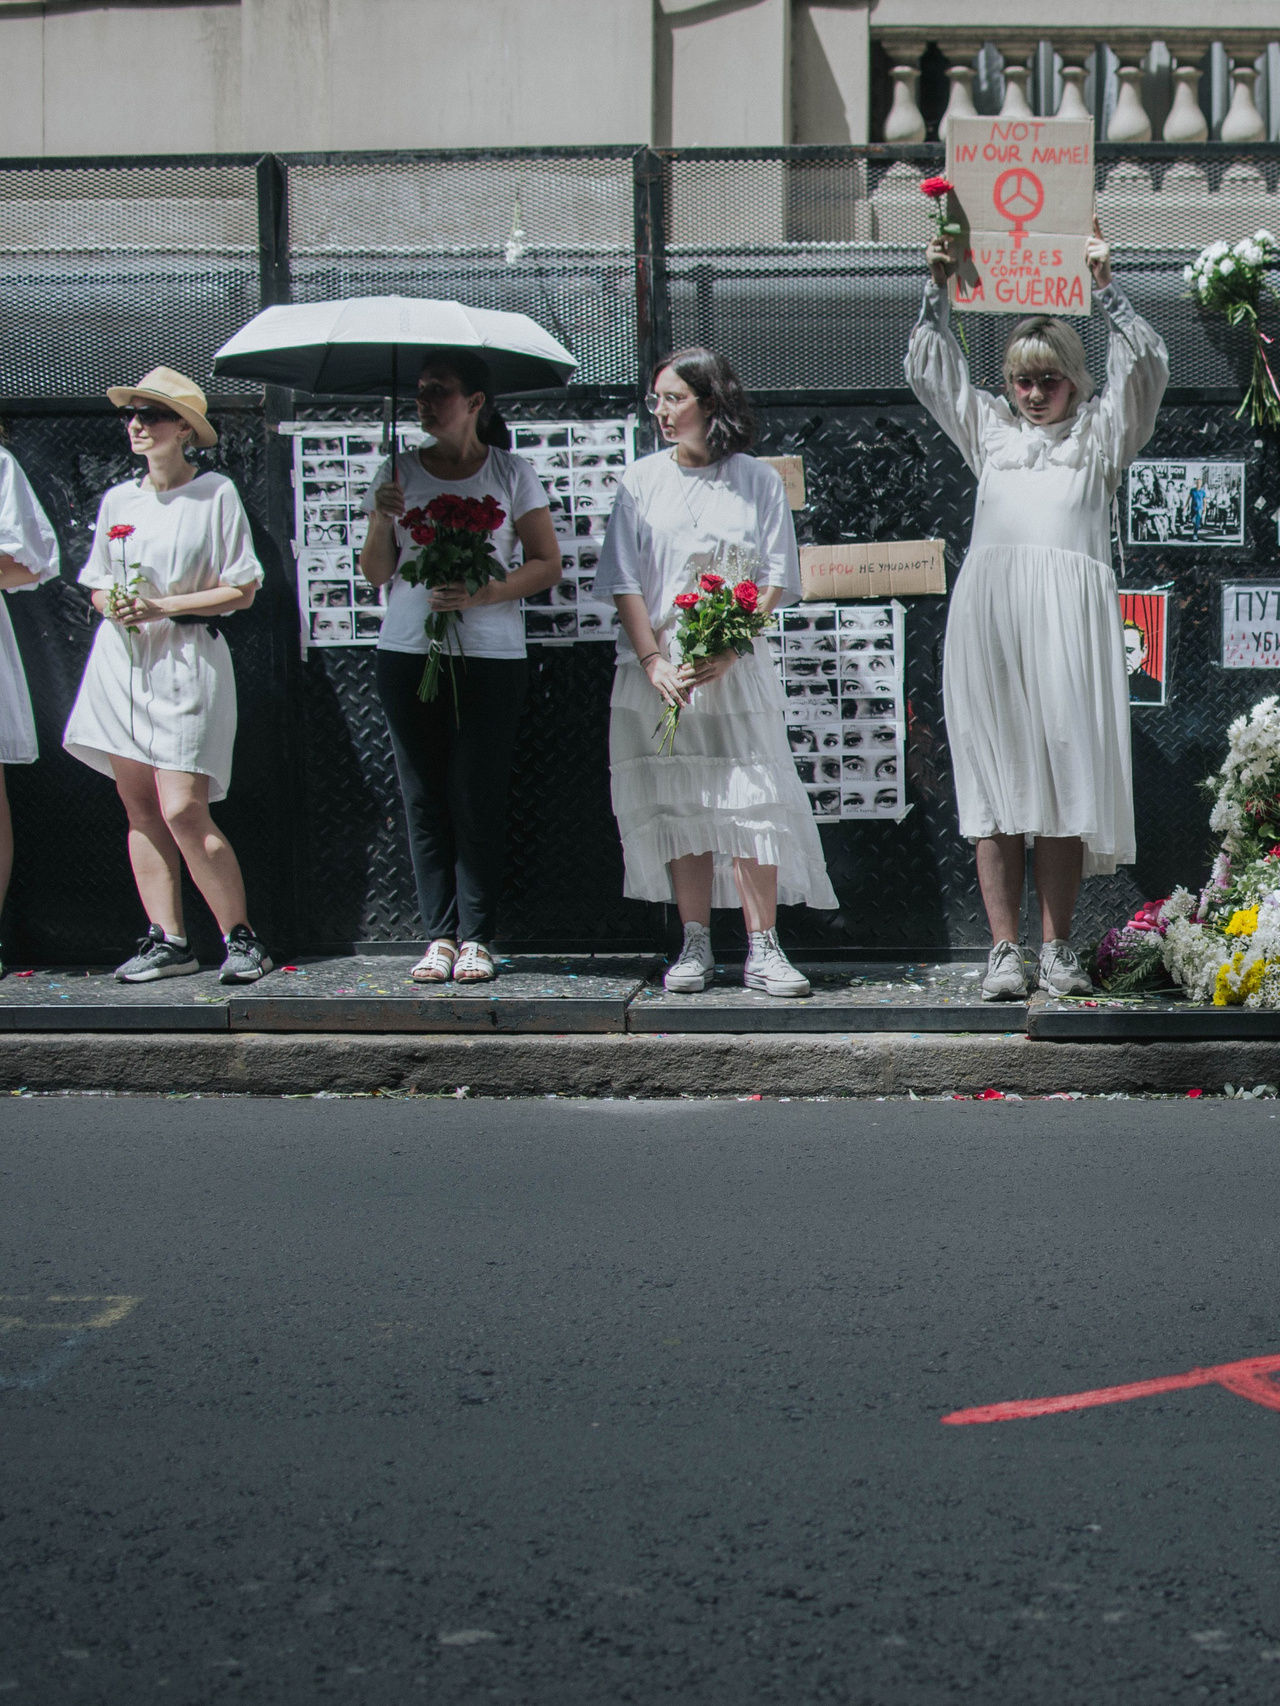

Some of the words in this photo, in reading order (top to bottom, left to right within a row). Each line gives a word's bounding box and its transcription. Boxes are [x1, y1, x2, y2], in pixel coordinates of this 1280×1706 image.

[990, 122, 1046, 142] NOT
[955, 145, 977, 162] IN
[983, 144, 1022, 162] OUR
[1031, 144, 1089, 165] NAME!
[964, 249, 1063, 266] MUJERES
[990, 266, 1041, 277] CONTRA
[955, 277, 985, 304] LA
[995, 276, 1084, 307] GUERRA
[859, 563, 875, 574] НЕ
